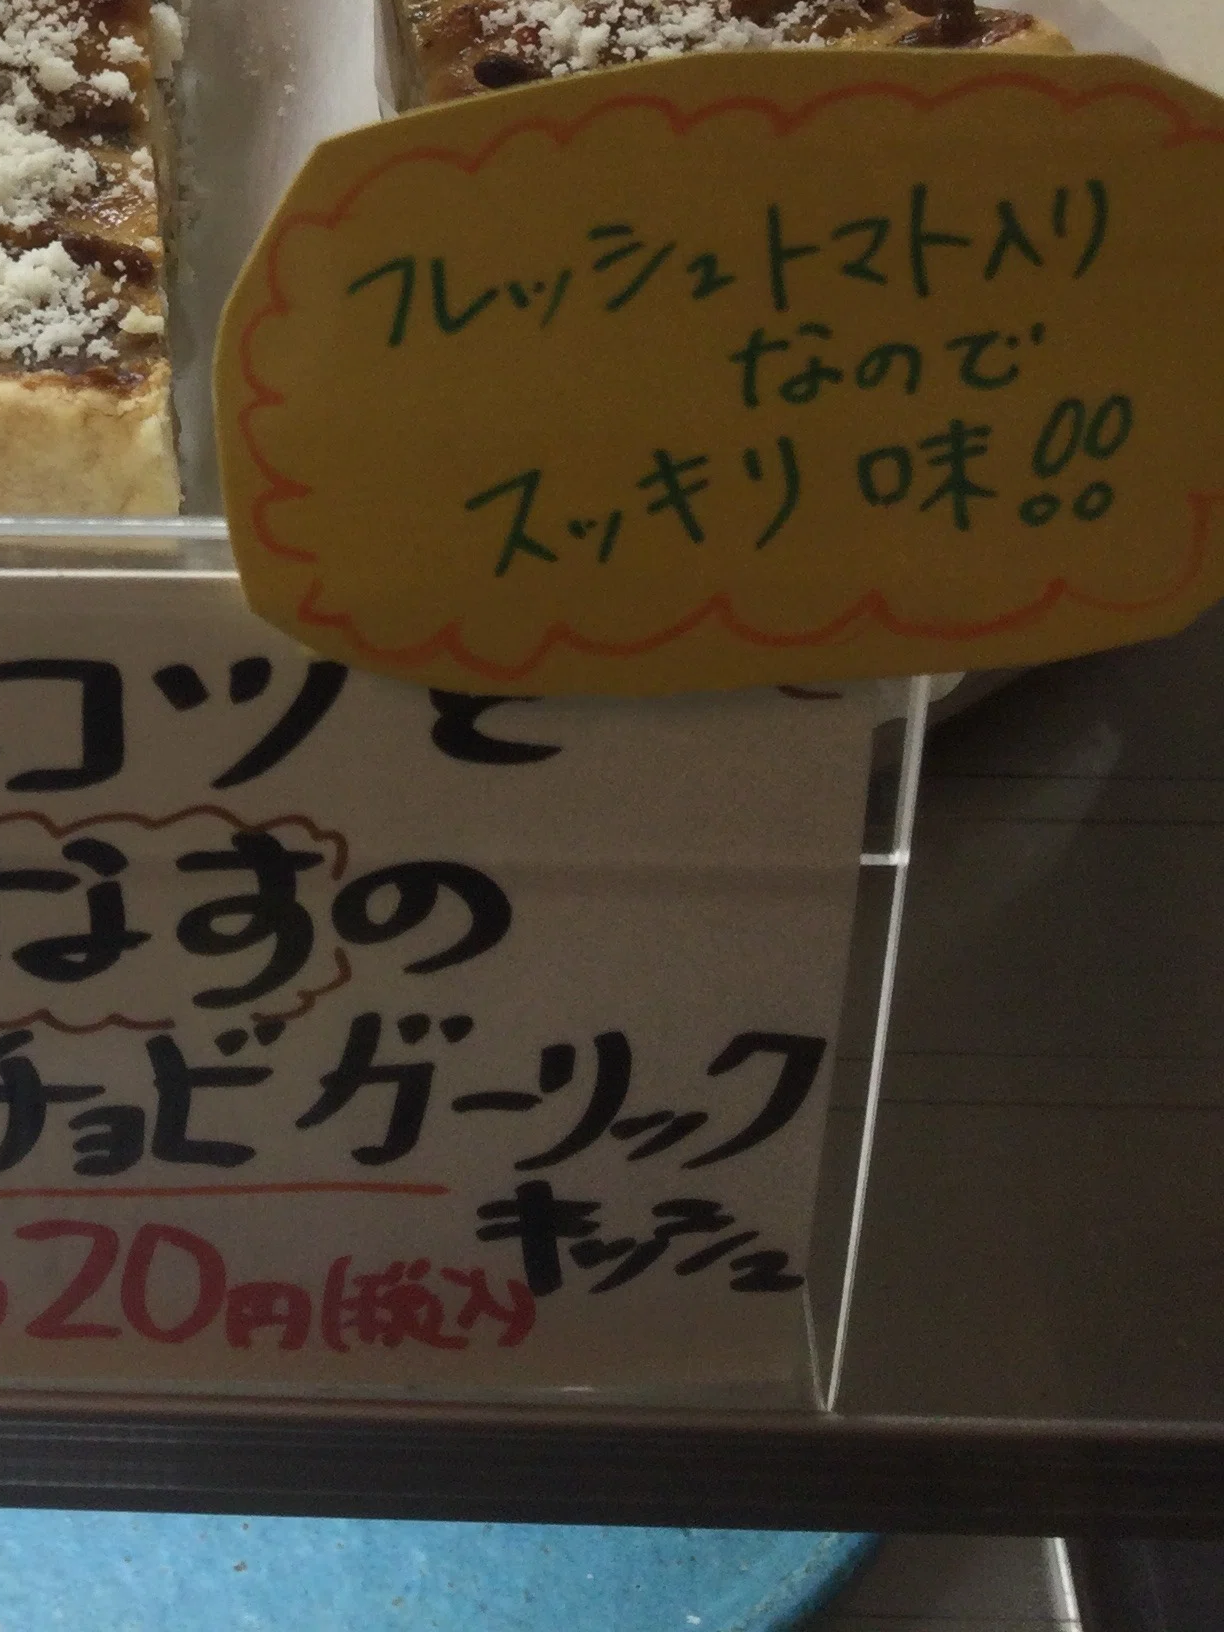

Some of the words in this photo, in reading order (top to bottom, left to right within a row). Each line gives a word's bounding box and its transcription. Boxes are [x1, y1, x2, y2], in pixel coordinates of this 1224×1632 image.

[730, 322, 1046, 408] なので
[474, 1180, 806, 1298] キッシュ
